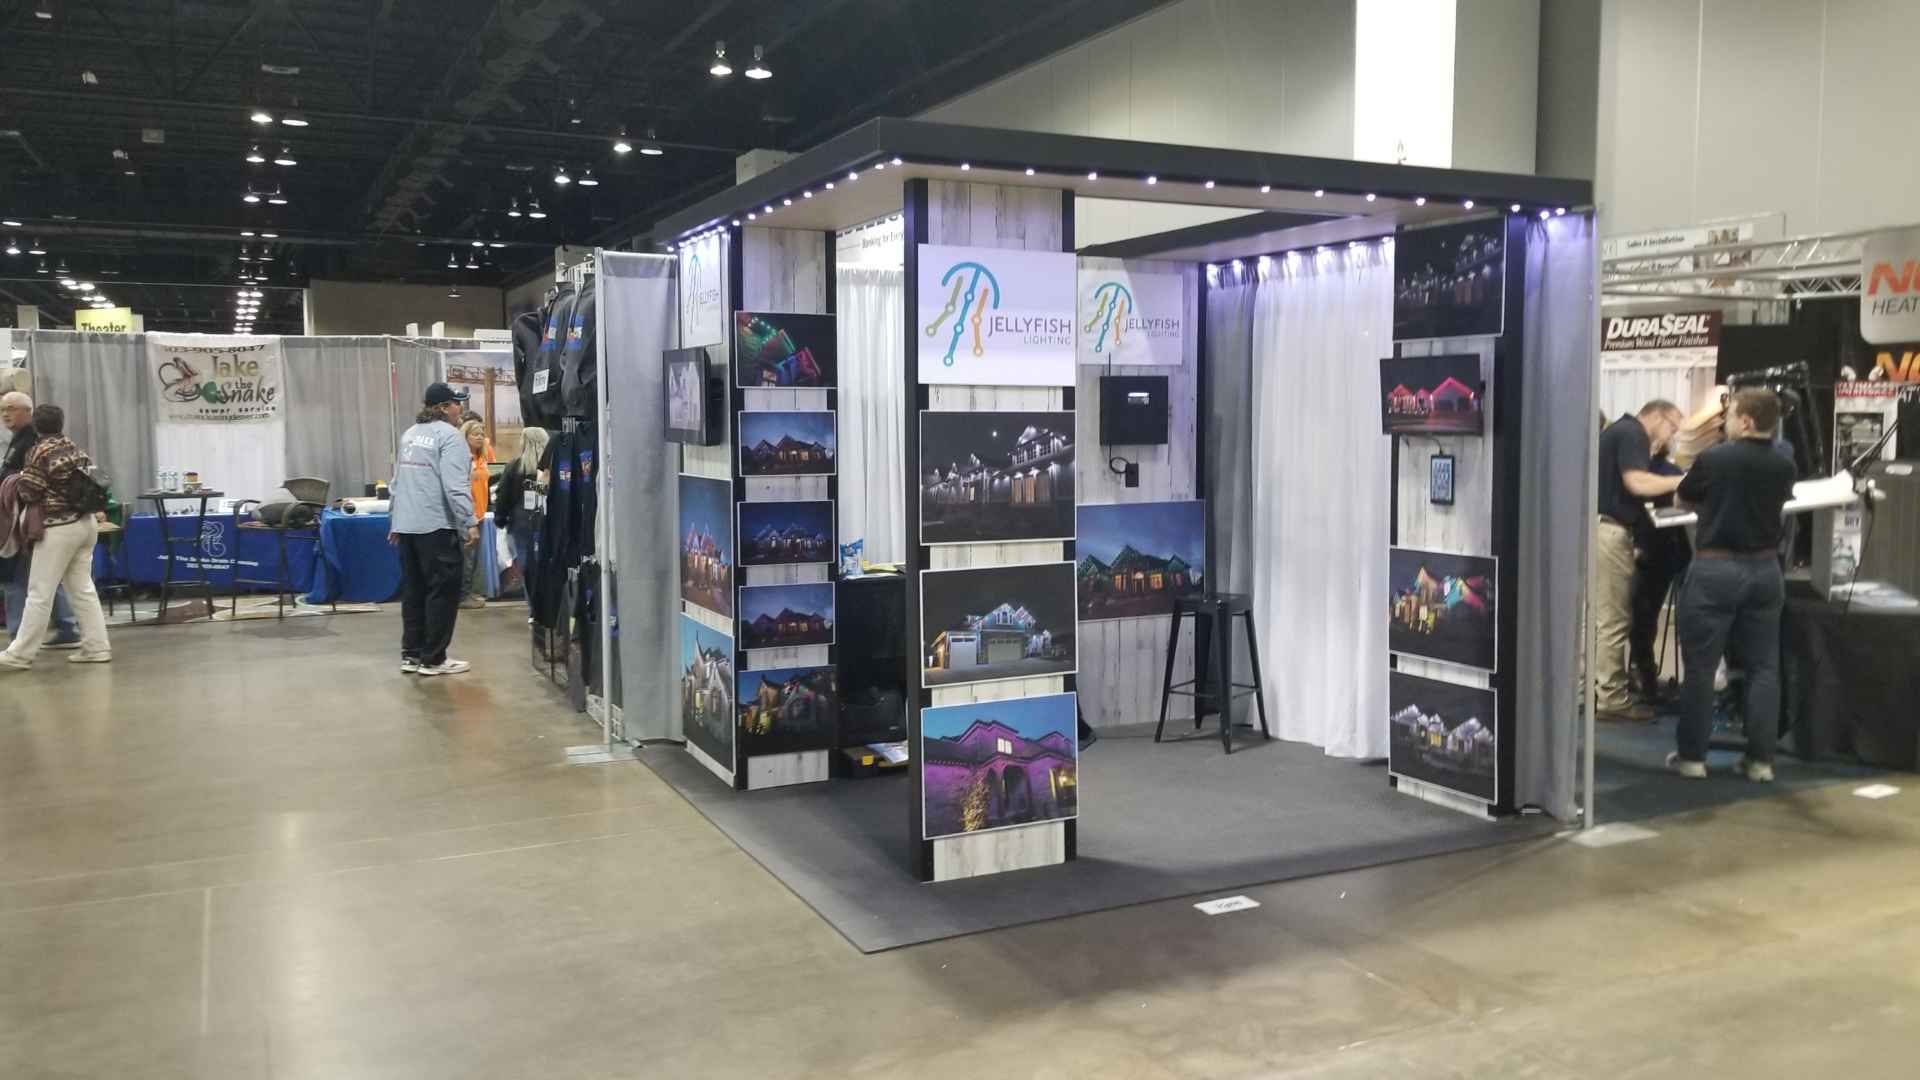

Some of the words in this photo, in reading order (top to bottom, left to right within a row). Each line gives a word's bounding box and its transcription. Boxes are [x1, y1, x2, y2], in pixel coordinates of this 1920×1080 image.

[988, 316, 1072, 337] JELLYFISH
[1124, 317, 1180, 333] JELLYFISH
[1023, 335, 1072, 346] LIGHTING
[212, 354, 259, 377] Jake
[217, 376, 275, 404] Snake
[235, 377, 253, 389] the
